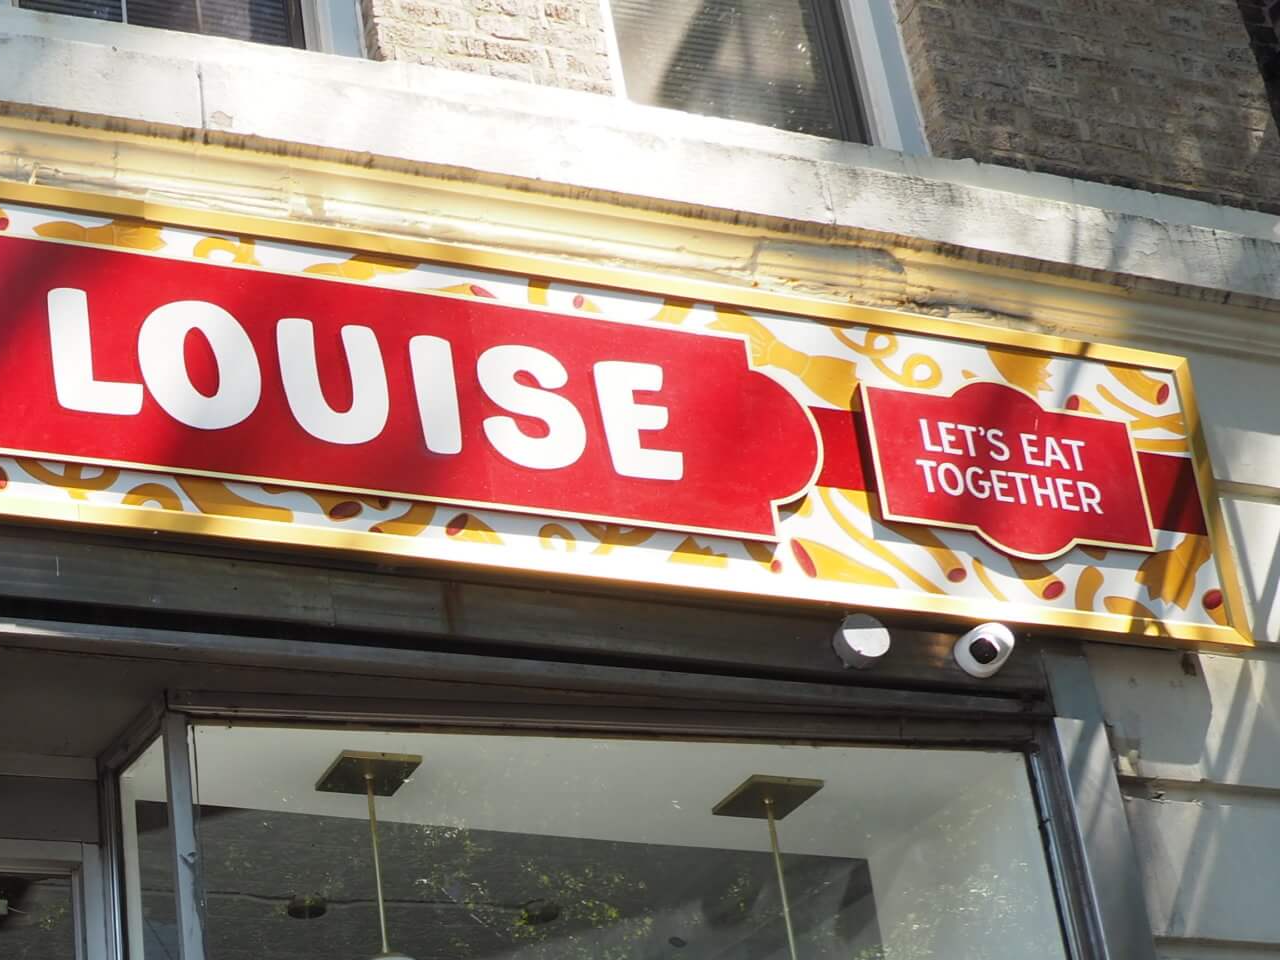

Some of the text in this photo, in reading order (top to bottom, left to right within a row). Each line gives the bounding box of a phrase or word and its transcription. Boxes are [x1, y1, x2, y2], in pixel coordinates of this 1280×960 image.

[46, 287, 685, 482] LOUISE
[919, 418, 1085, 471] LET'S EAT
[915, 459, 1104, 515] TOGETHER
